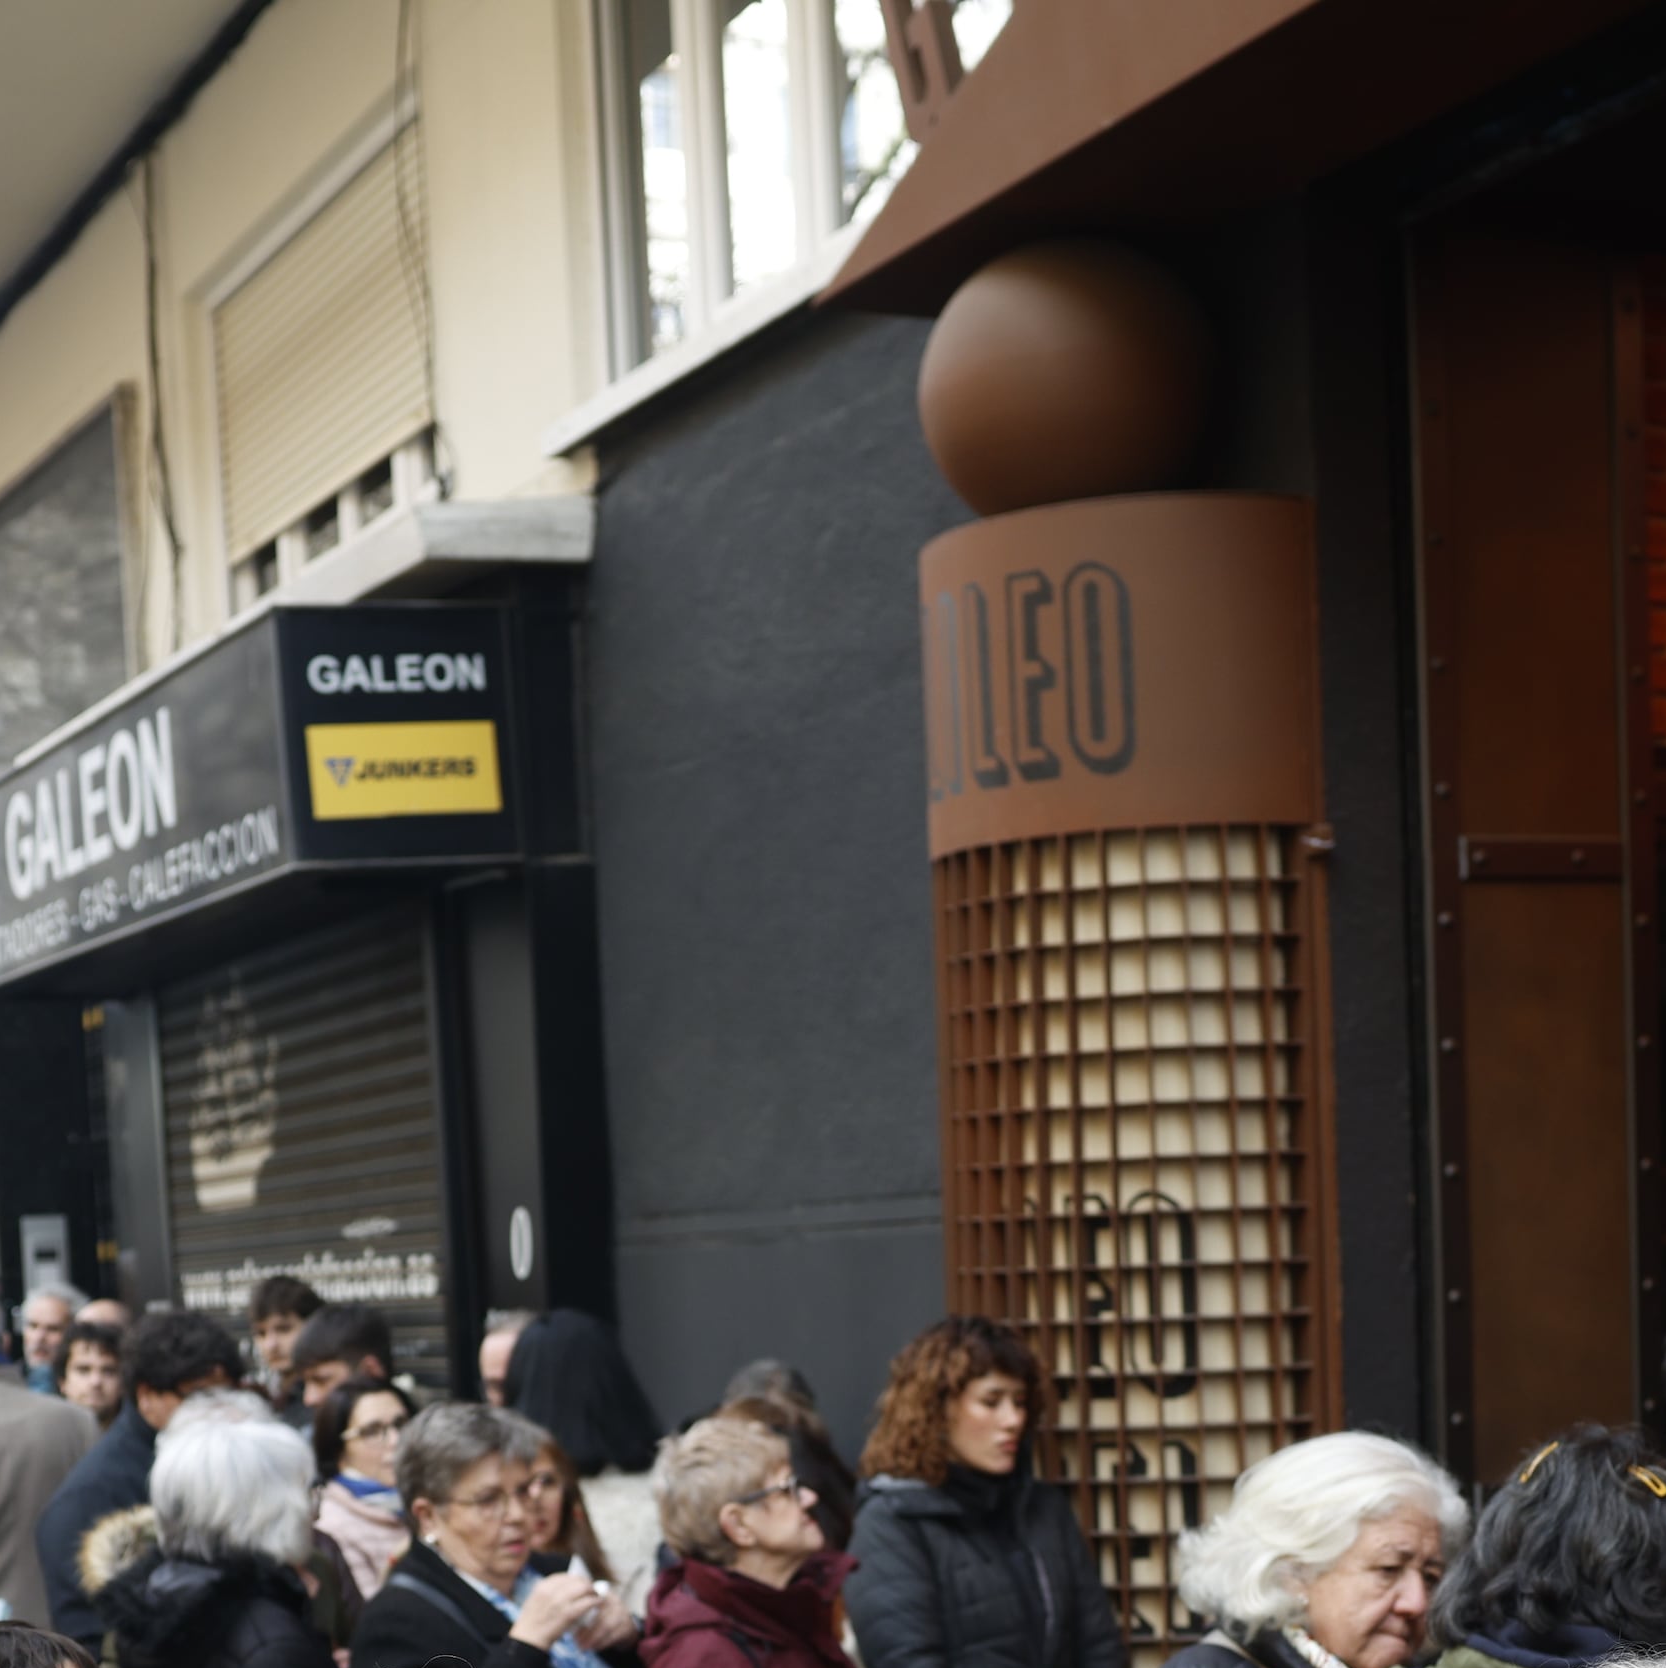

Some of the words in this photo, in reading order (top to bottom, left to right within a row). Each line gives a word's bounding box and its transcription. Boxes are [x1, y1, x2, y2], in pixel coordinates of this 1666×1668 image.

[305, 653, 488, 694] GALEON
[355, 756, 477, 781] JUNKERS
[5, 704, 178, 901] GALEON
